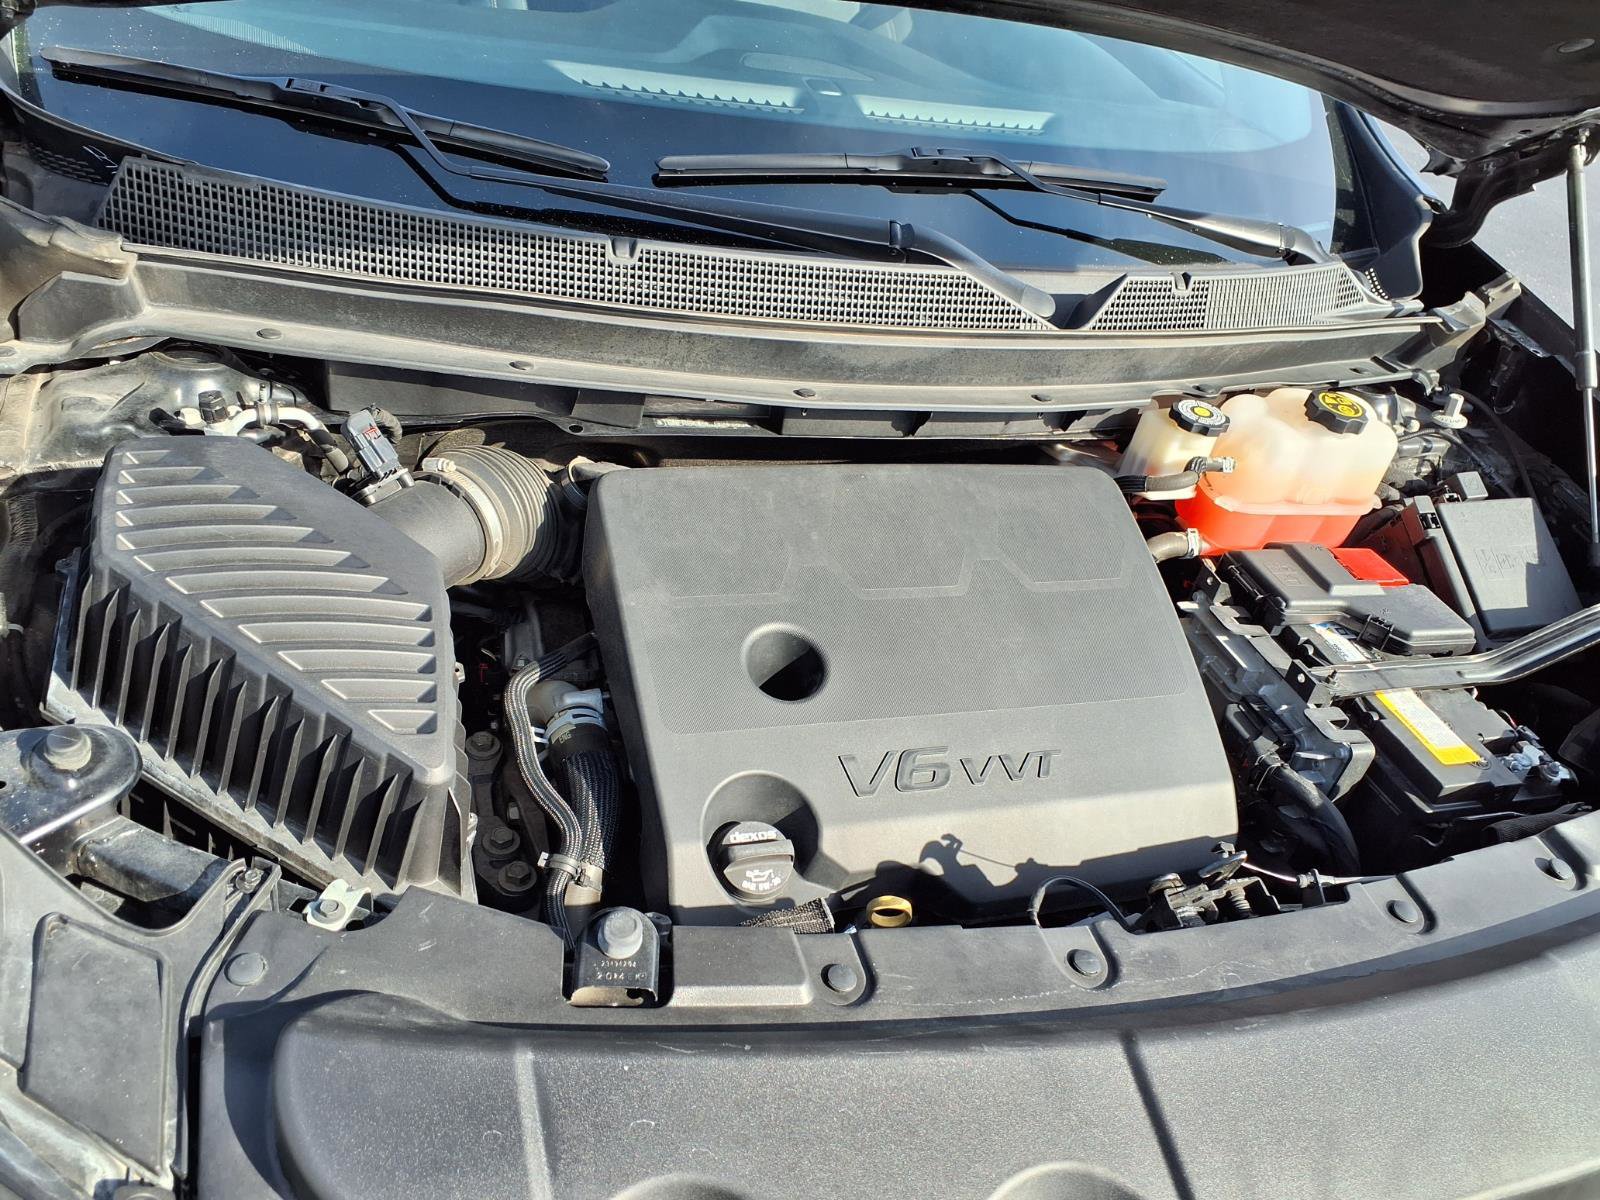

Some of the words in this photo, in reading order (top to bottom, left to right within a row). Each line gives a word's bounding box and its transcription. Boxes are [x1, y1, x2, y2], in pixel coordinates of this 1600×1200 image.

[838, 746, 951, 797] V6
[959, 749, 1061, 786] VVT
[729, 830, 777, 843] dexos
